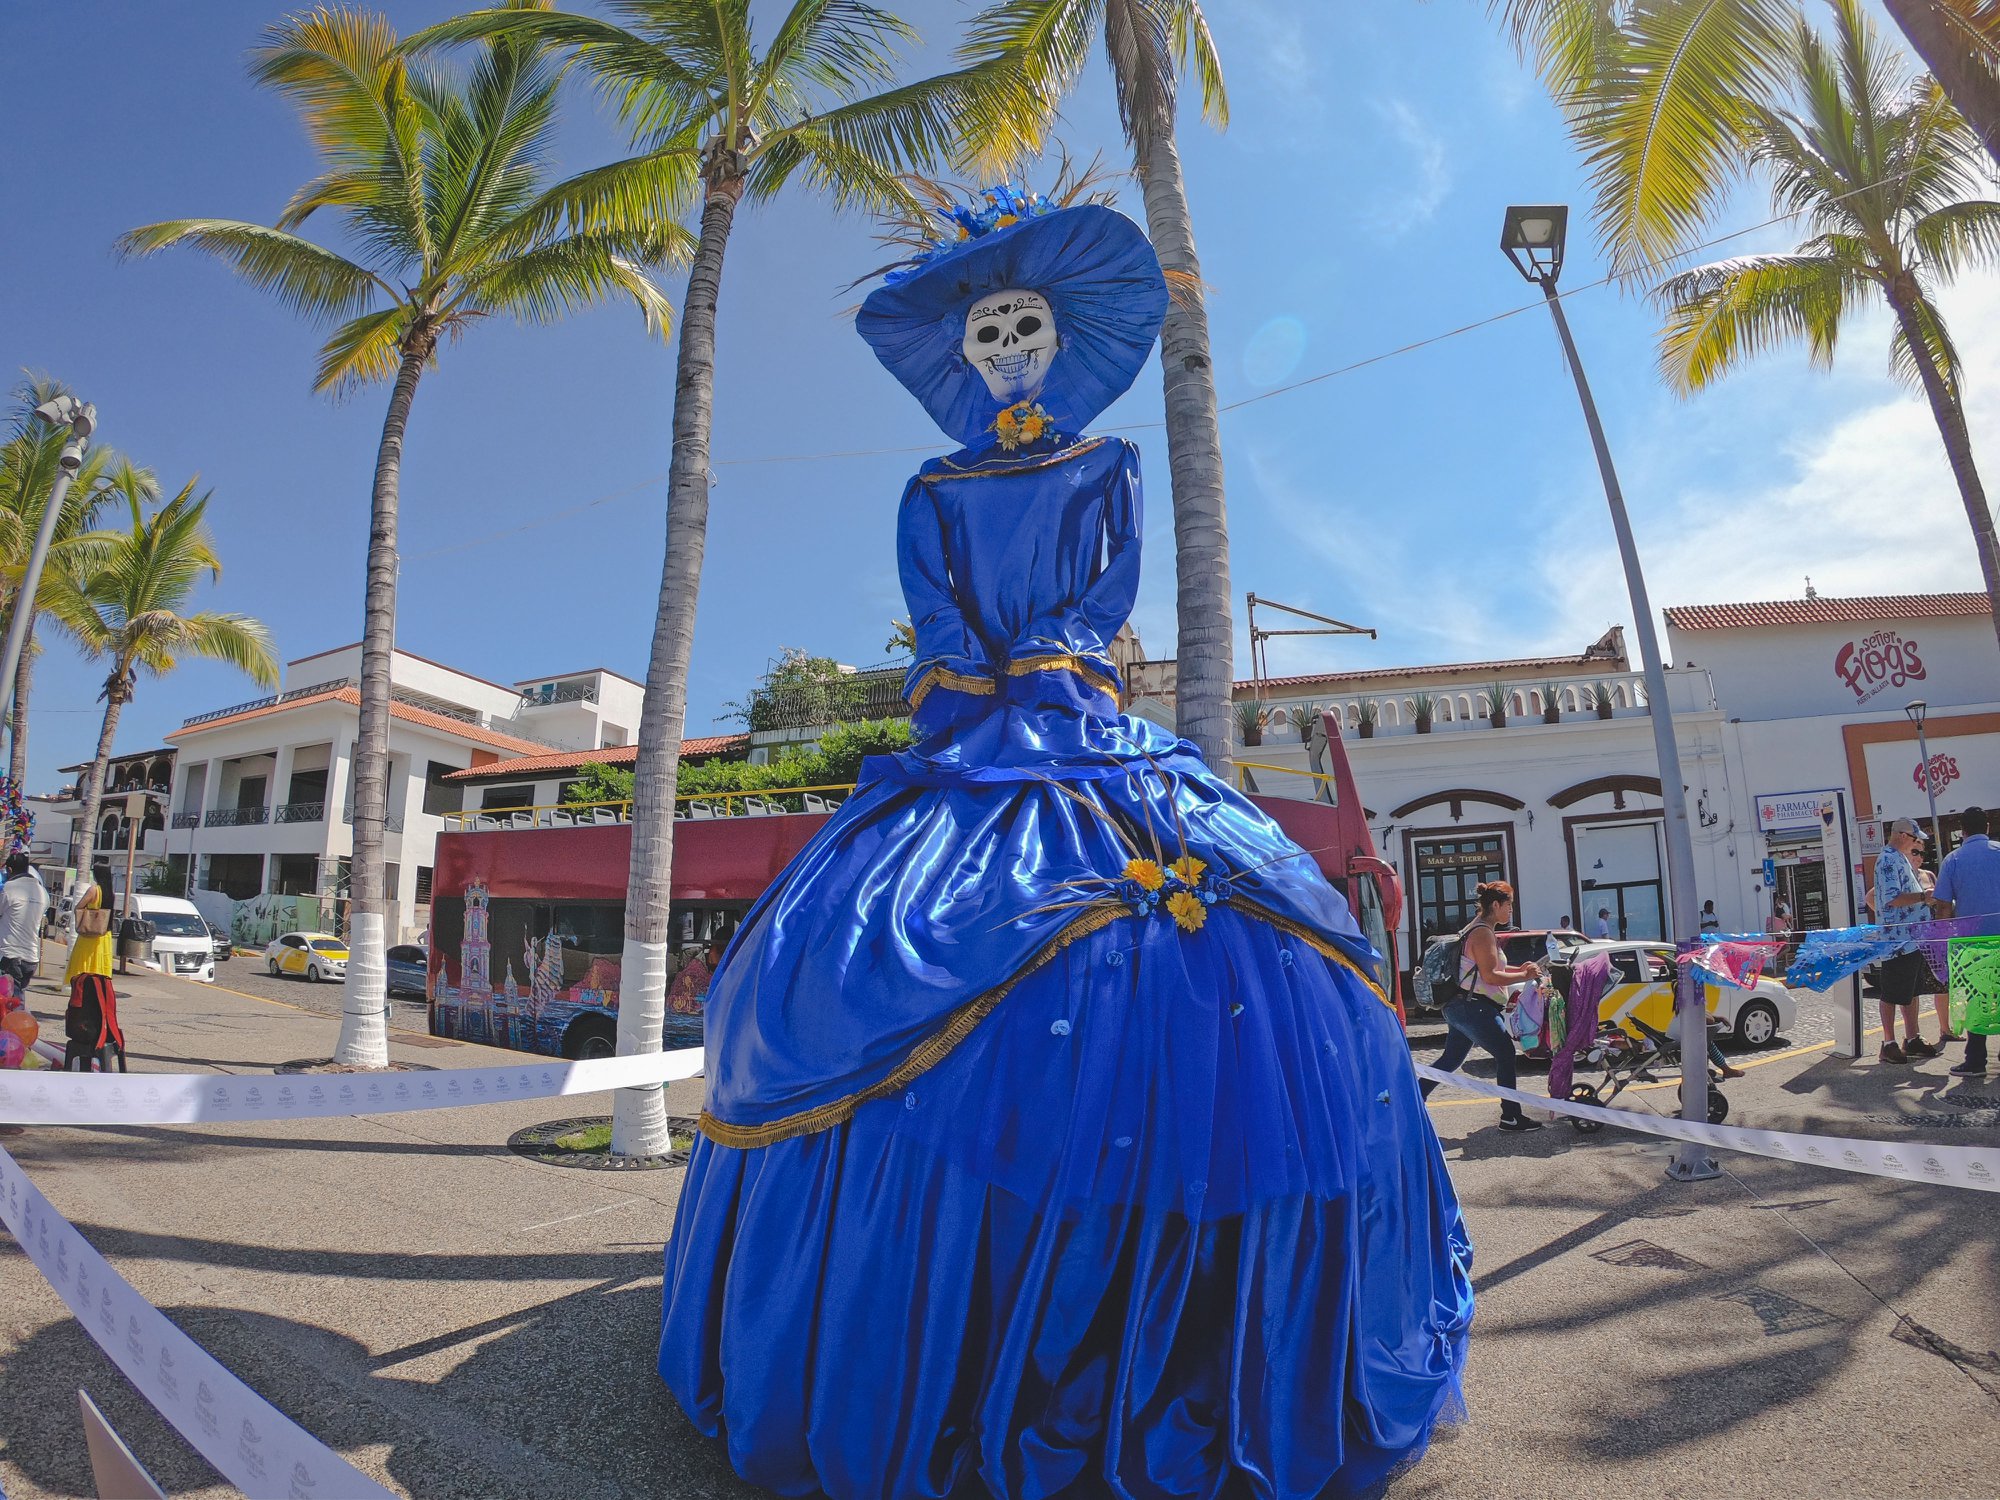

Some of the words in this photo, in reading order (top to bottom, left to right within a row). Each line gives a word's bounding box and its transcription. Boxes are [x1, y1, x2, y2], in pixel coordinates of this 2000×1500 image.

[1862, 630, 1896, 652] señor
[1835, 637, 1927, 697] Frog's
[1856, 693, 1871, 706] PUERTO
[1870, 680, 1890, 696] VALLARTA
[1448, 856, 1455, 864] &
